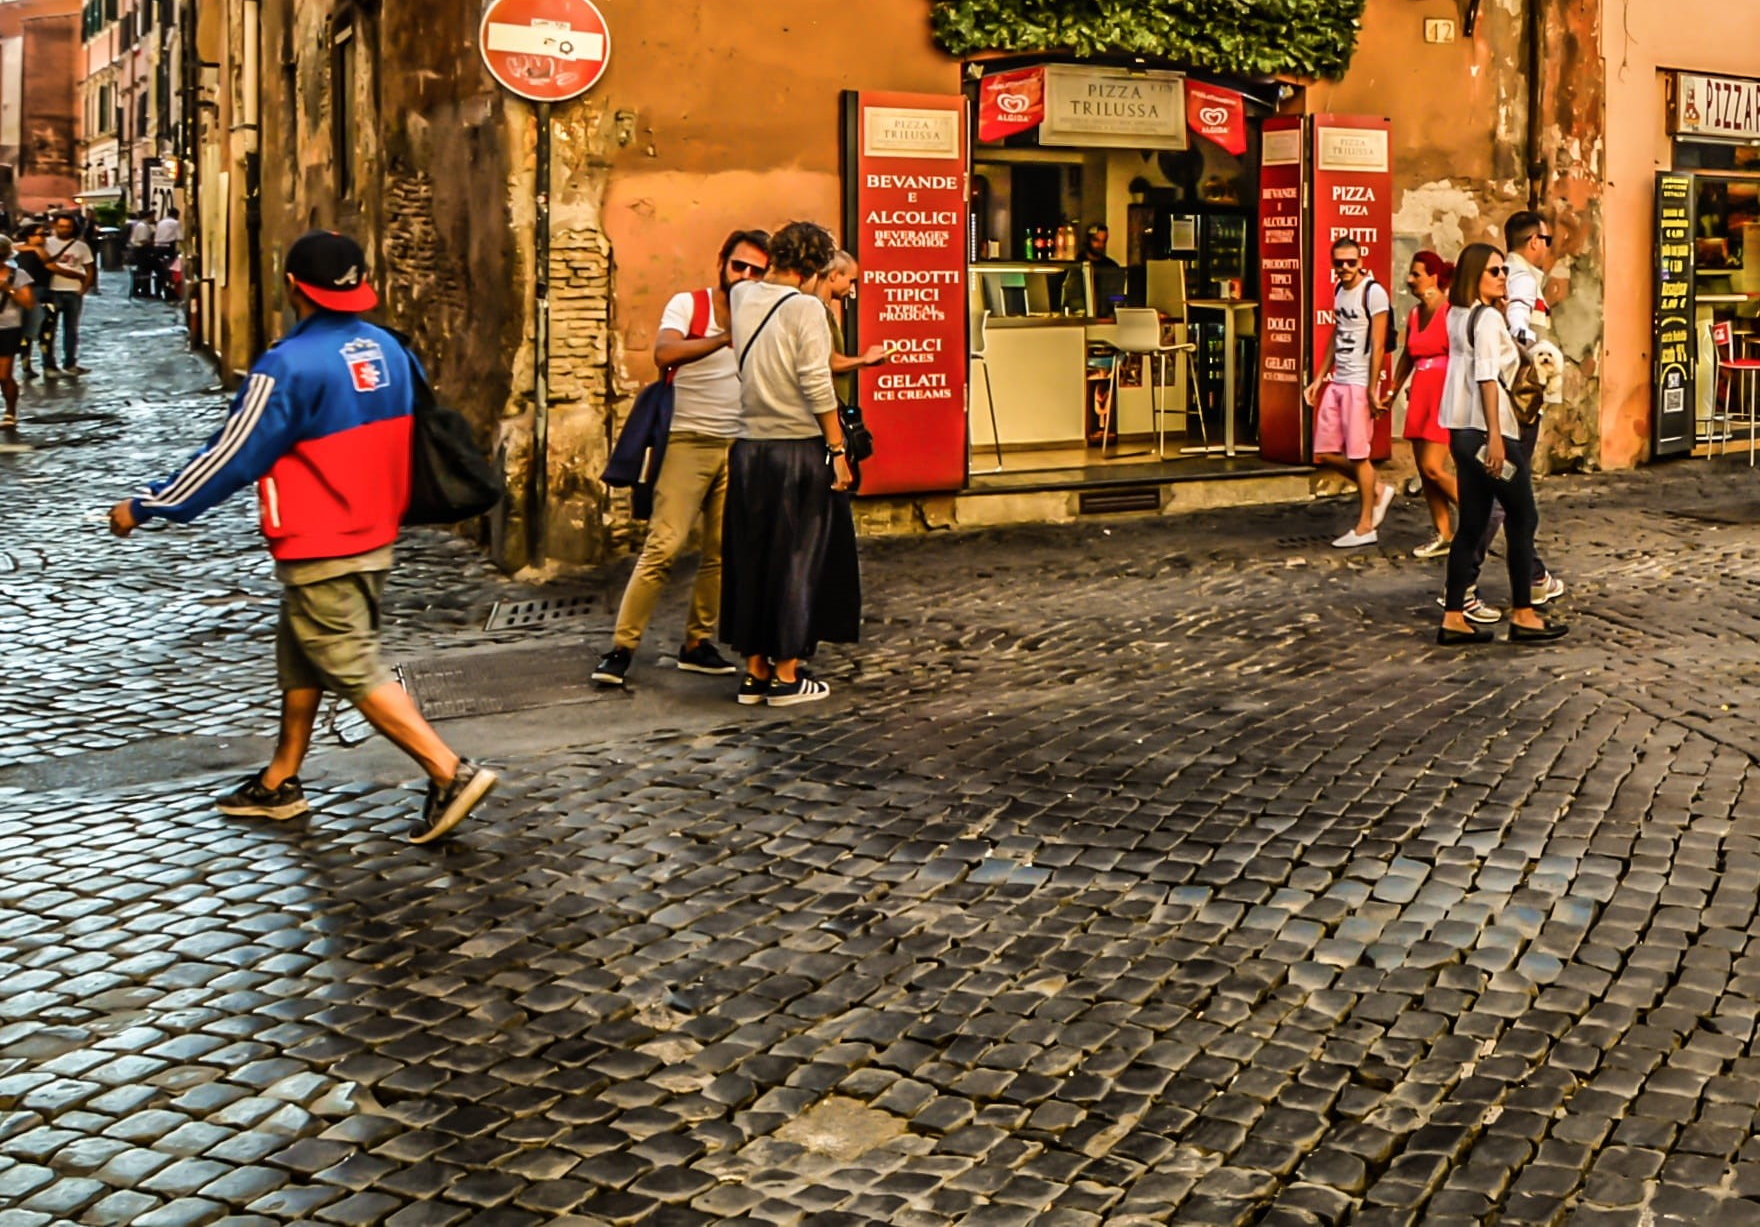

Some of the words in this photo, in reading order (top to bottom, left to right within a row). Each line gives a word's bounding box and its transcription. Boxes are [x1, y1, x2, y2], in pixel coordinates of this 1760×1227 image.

[1088, 83, 1142, 99] PIZZA
[1070, 100, 1159, 118] TRILUSSA
[894, 119, 929, 129] PIZZA
[997, 114, 1029, 122] ALGIDA
[883, 129, 941, 141] TRILUSSA
[866, 174, 958, 190] BEVANDE
[908, 192, 917, 203] E
[1332, 185, 1376, 202] PIZZA
[1339, 204, 1369, 215] PIZZA
[865, 211, 957, 225] ALCOLICI
[874, 230, 949, 240] BEVERAGES
[874, 237, 884, 247] &
[887, 238, 947, 247] ALCOHOL
[863, 270, 959, 284] PRODOTTI
[883, 288, 939, 302] TIPICI
[885, 304, 937, 314] TYPICAL
[879, 311, 945, 322] PRODUCTS
[1267, 317, 1296, 331] DOLCI
[882, 338, 942, 352] DOLCI
[890, 353, 934, 364] CAKES
[1265, 356, 1297, 370] GELATI
[877, 373, 947, 388] GELATI
[873, 390, 895, 401] ICE
[897, 388, 952, 400] CREAMS
